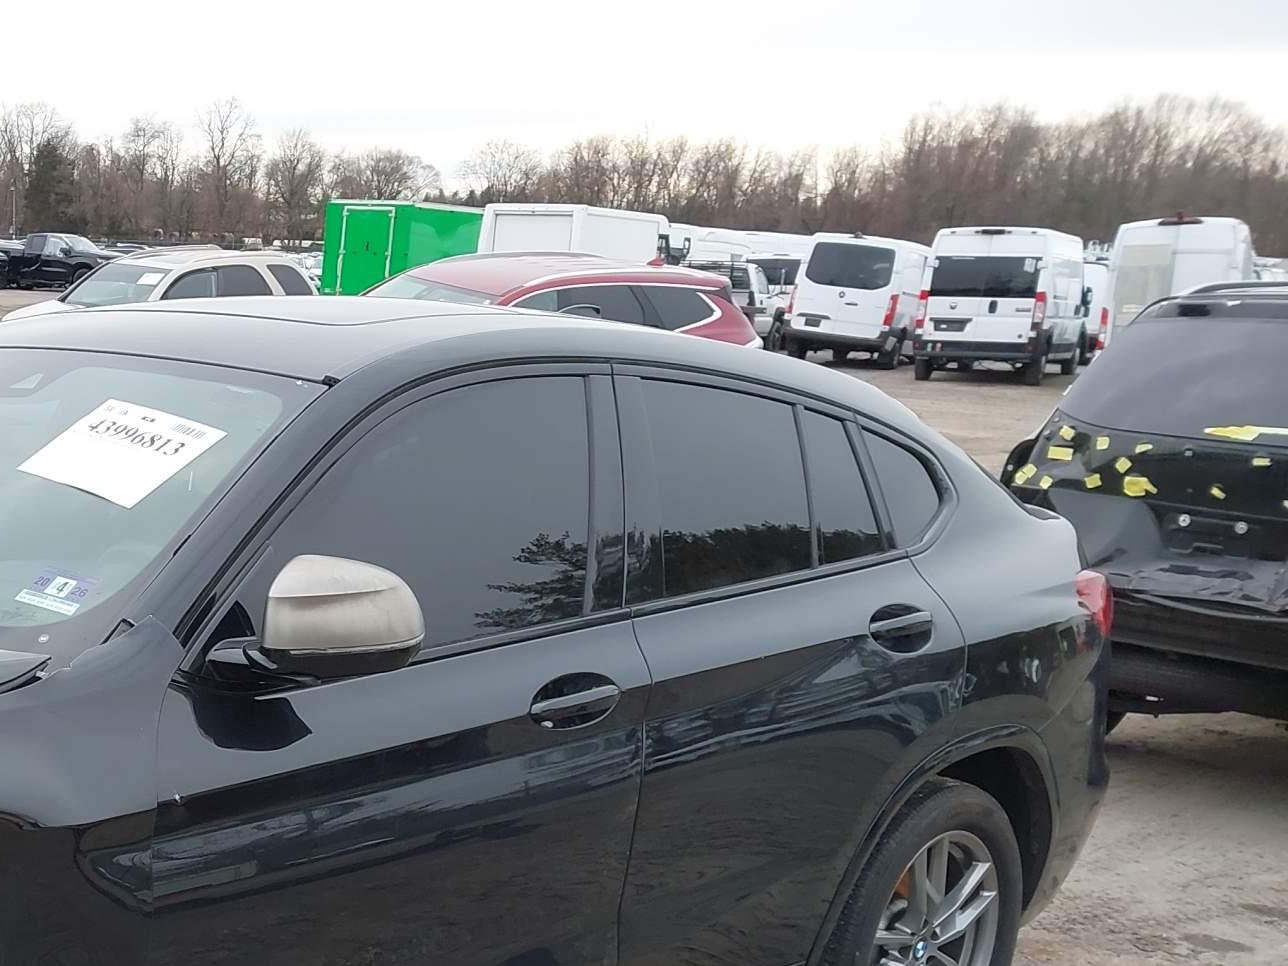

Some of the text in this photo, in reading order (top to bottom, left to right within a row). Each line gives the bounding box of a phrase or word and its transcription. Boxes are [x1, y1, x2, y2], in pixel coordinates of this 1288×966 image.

[87, 418, 186, 457] 43996813
[34, 575, 89, 598] 20 4 26
